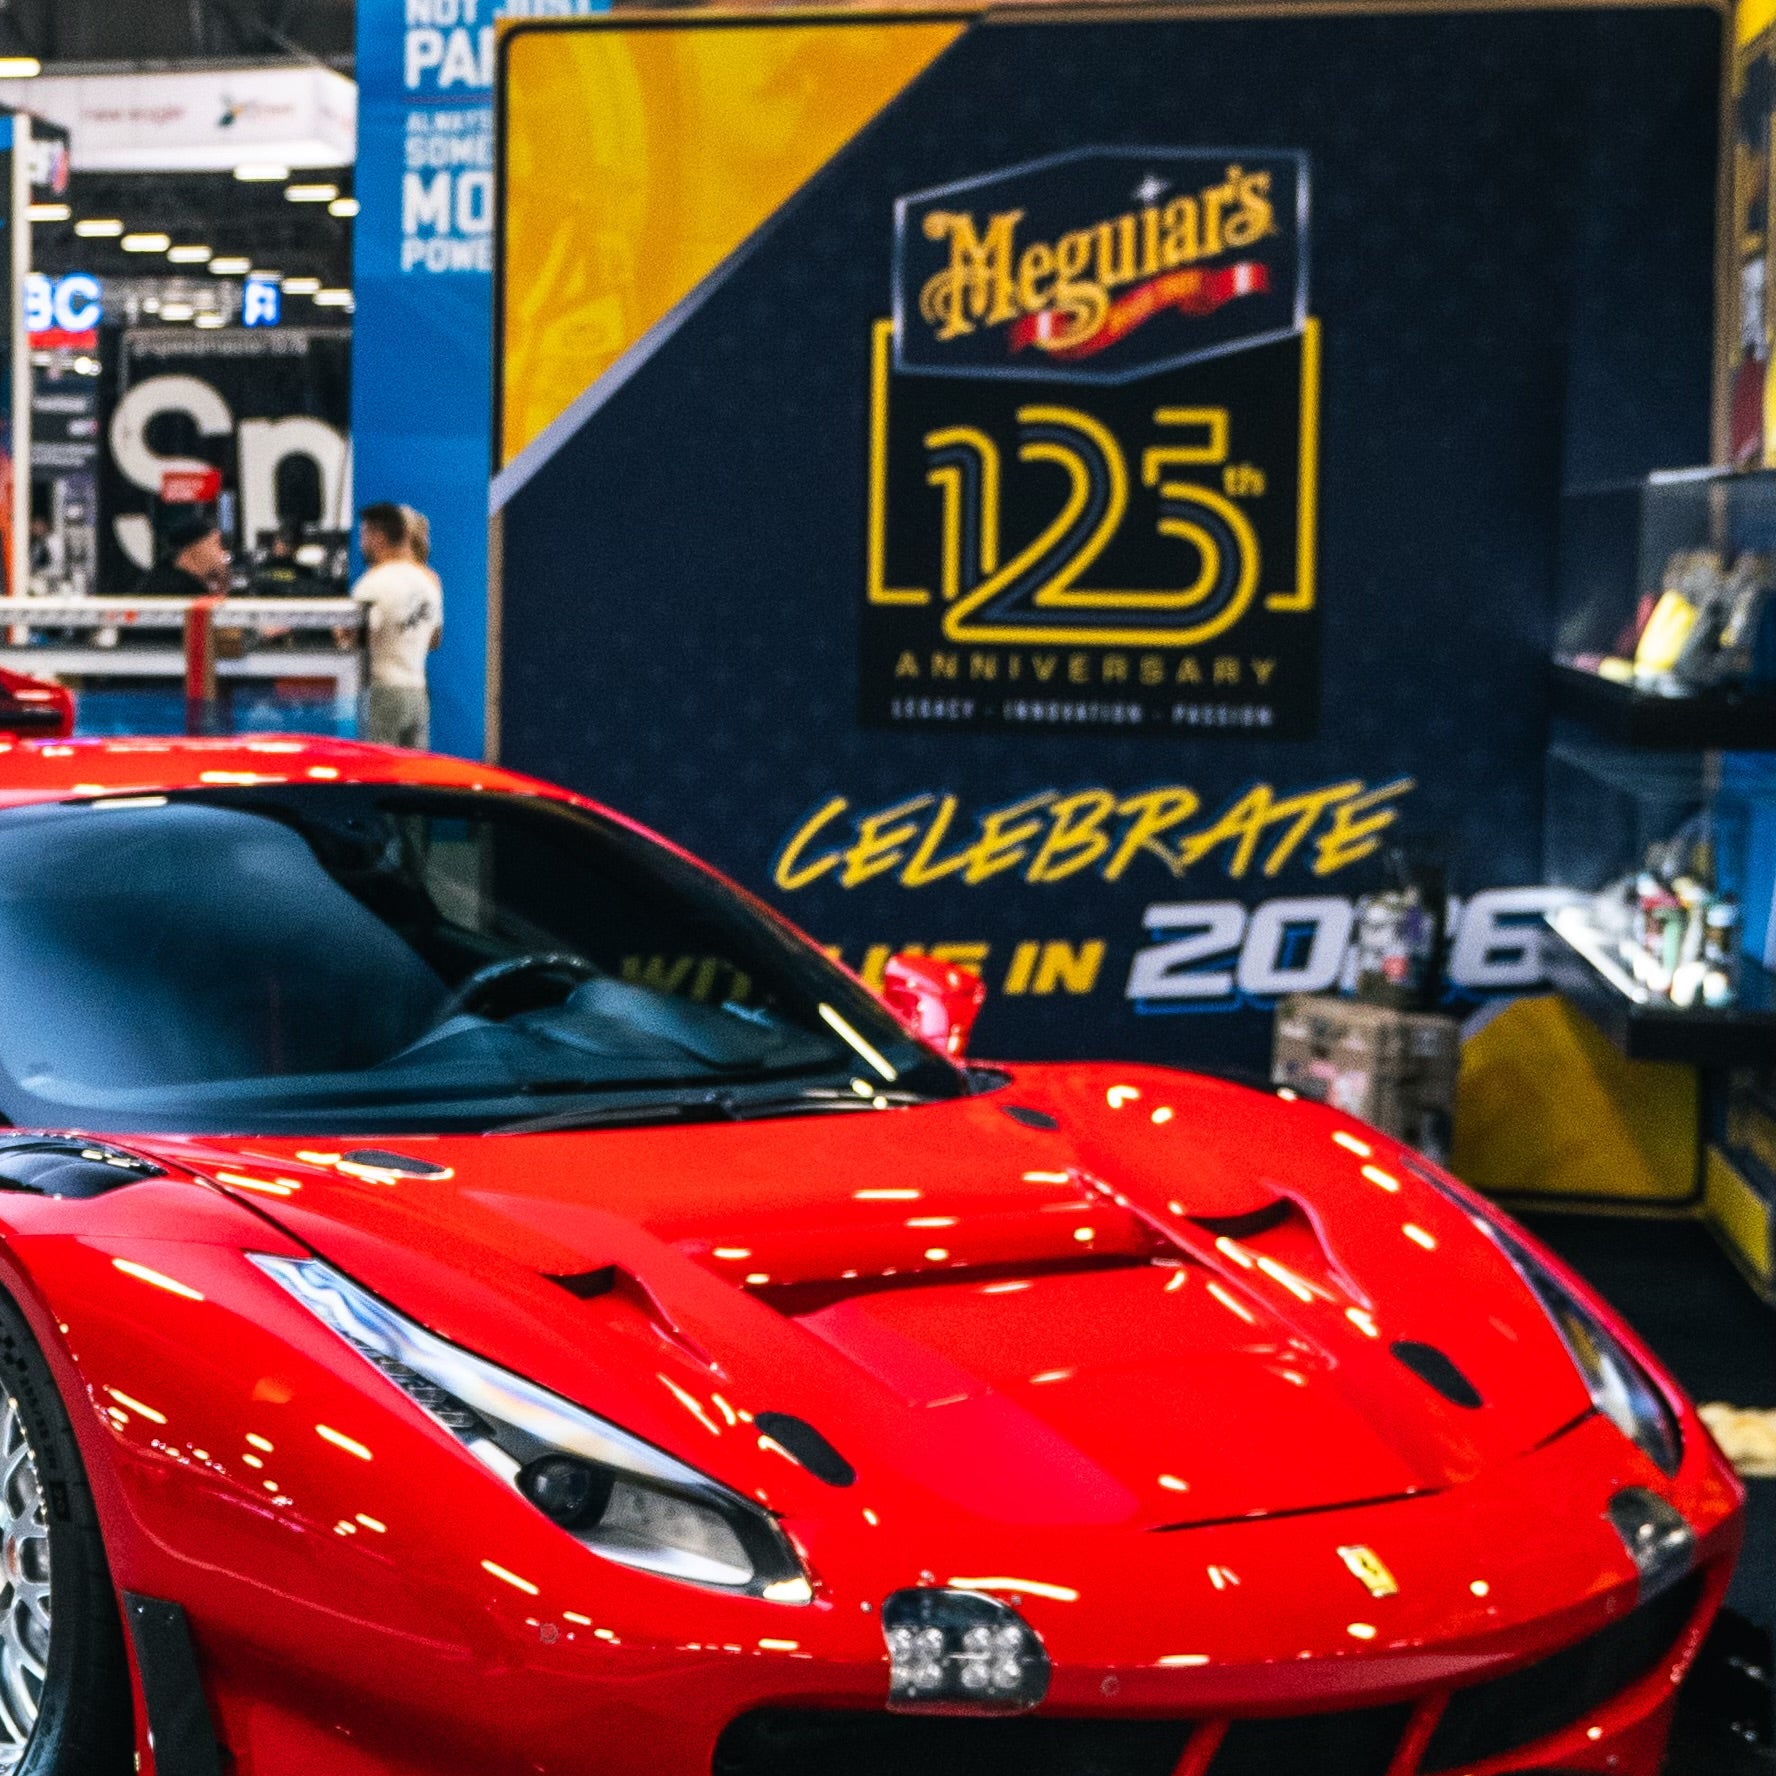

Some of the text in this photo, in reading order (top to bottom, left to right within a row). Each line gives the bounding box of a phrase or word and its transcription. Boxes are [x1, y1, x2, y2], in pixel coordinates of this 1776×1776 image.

[918, 164, 1278, 351] Meguiar's
[895, 650, 1277, 685] ANNIVERSARY
[774, 775, 1418, 893] CELEBRATE
[1003, 938, 1107, 995] IN
[1124, 887, 1569, 1003] 206
